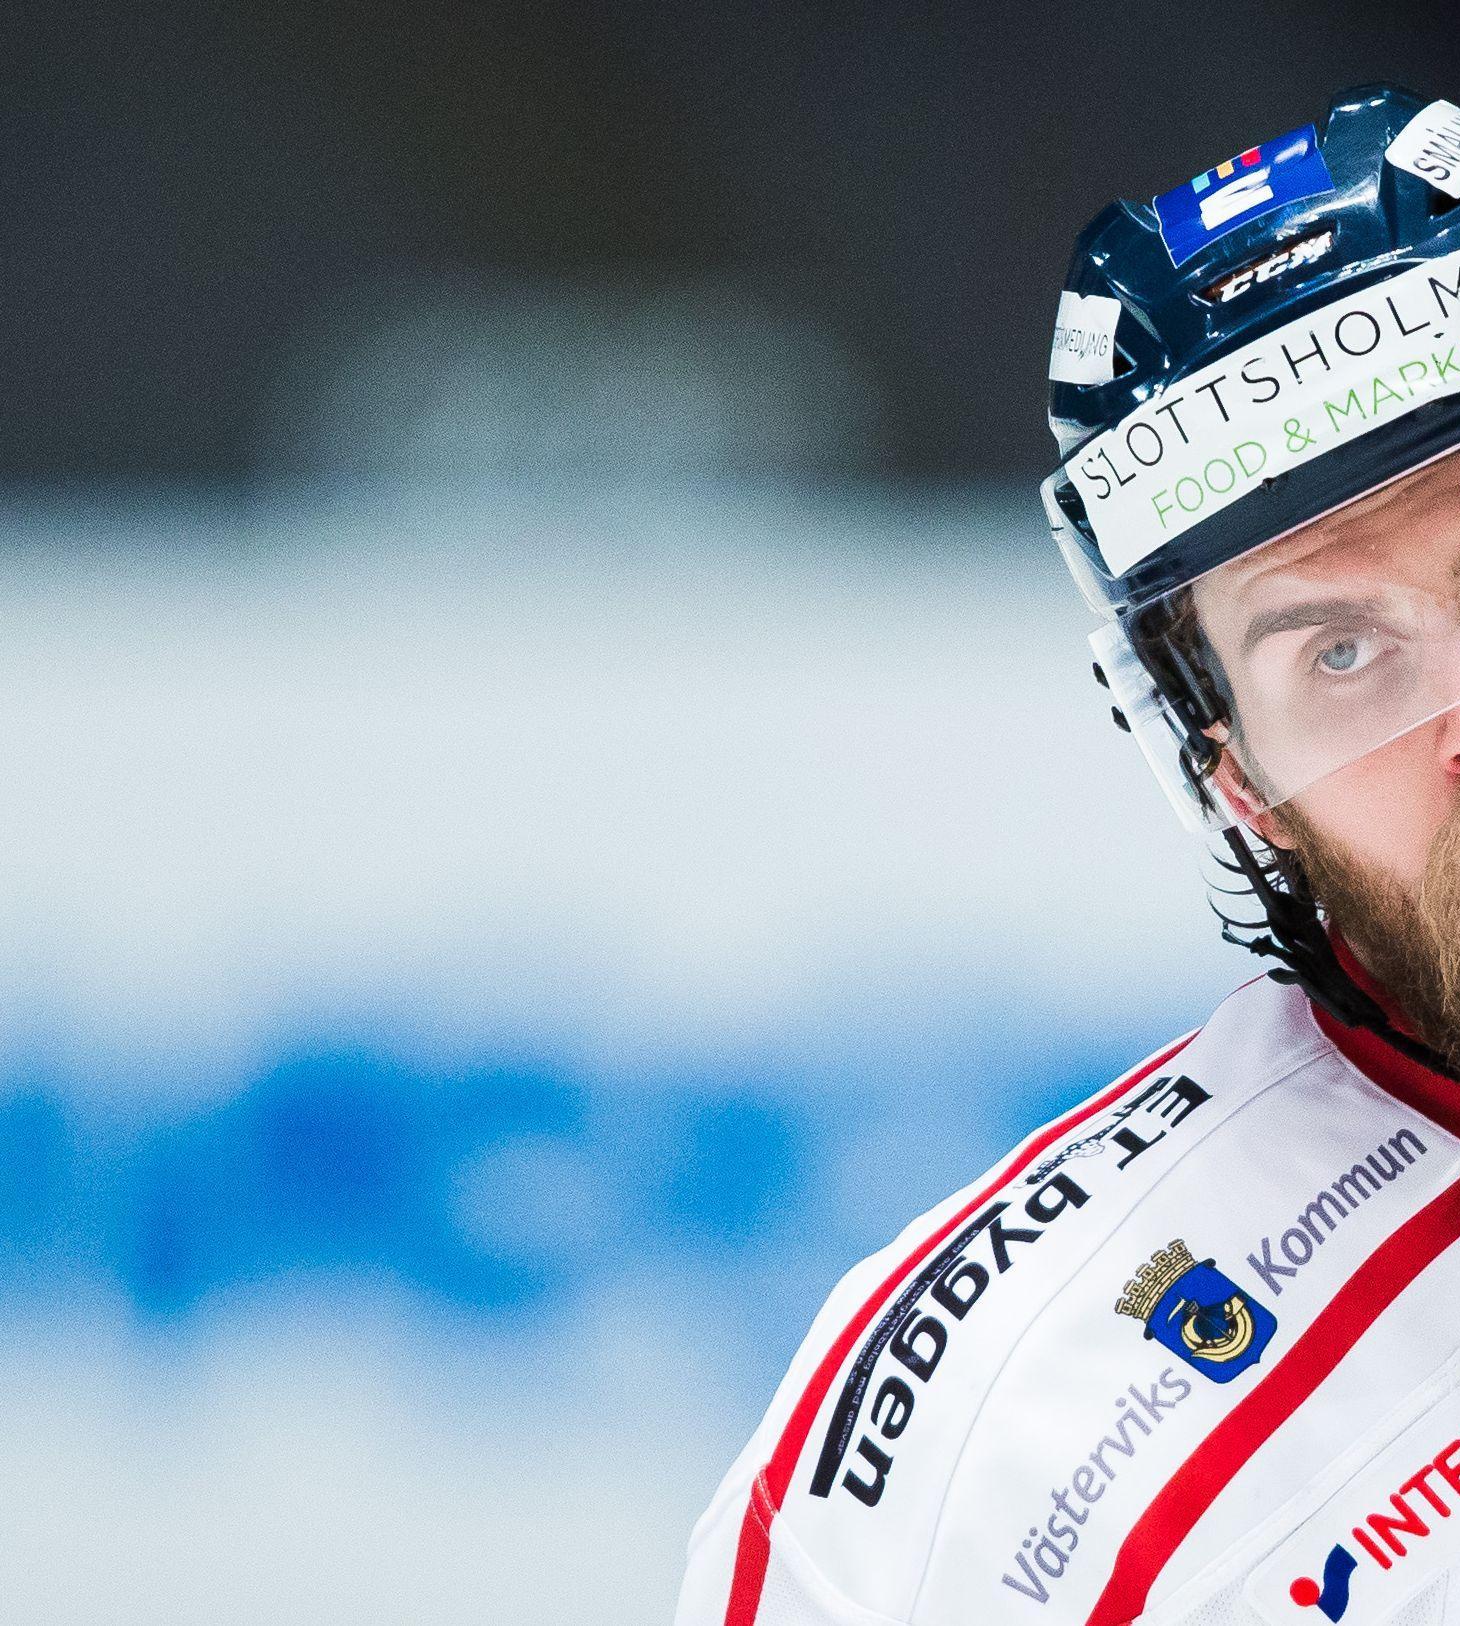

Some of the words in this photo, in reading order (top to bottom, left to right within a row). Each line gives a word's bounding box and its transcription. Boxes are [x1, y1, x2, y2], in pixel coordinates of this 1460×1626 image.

[1150, 440, 1268, 529] FOOD
[1281, 416, 1318, 455] &
[1111, 1075, 1213, 1171] ET
[841, 1171, 1093, 1508] byggen
[1001, 1366, 1192, 1607] Västerviks
[1245, 1124, 1428, 1297] Kommun
